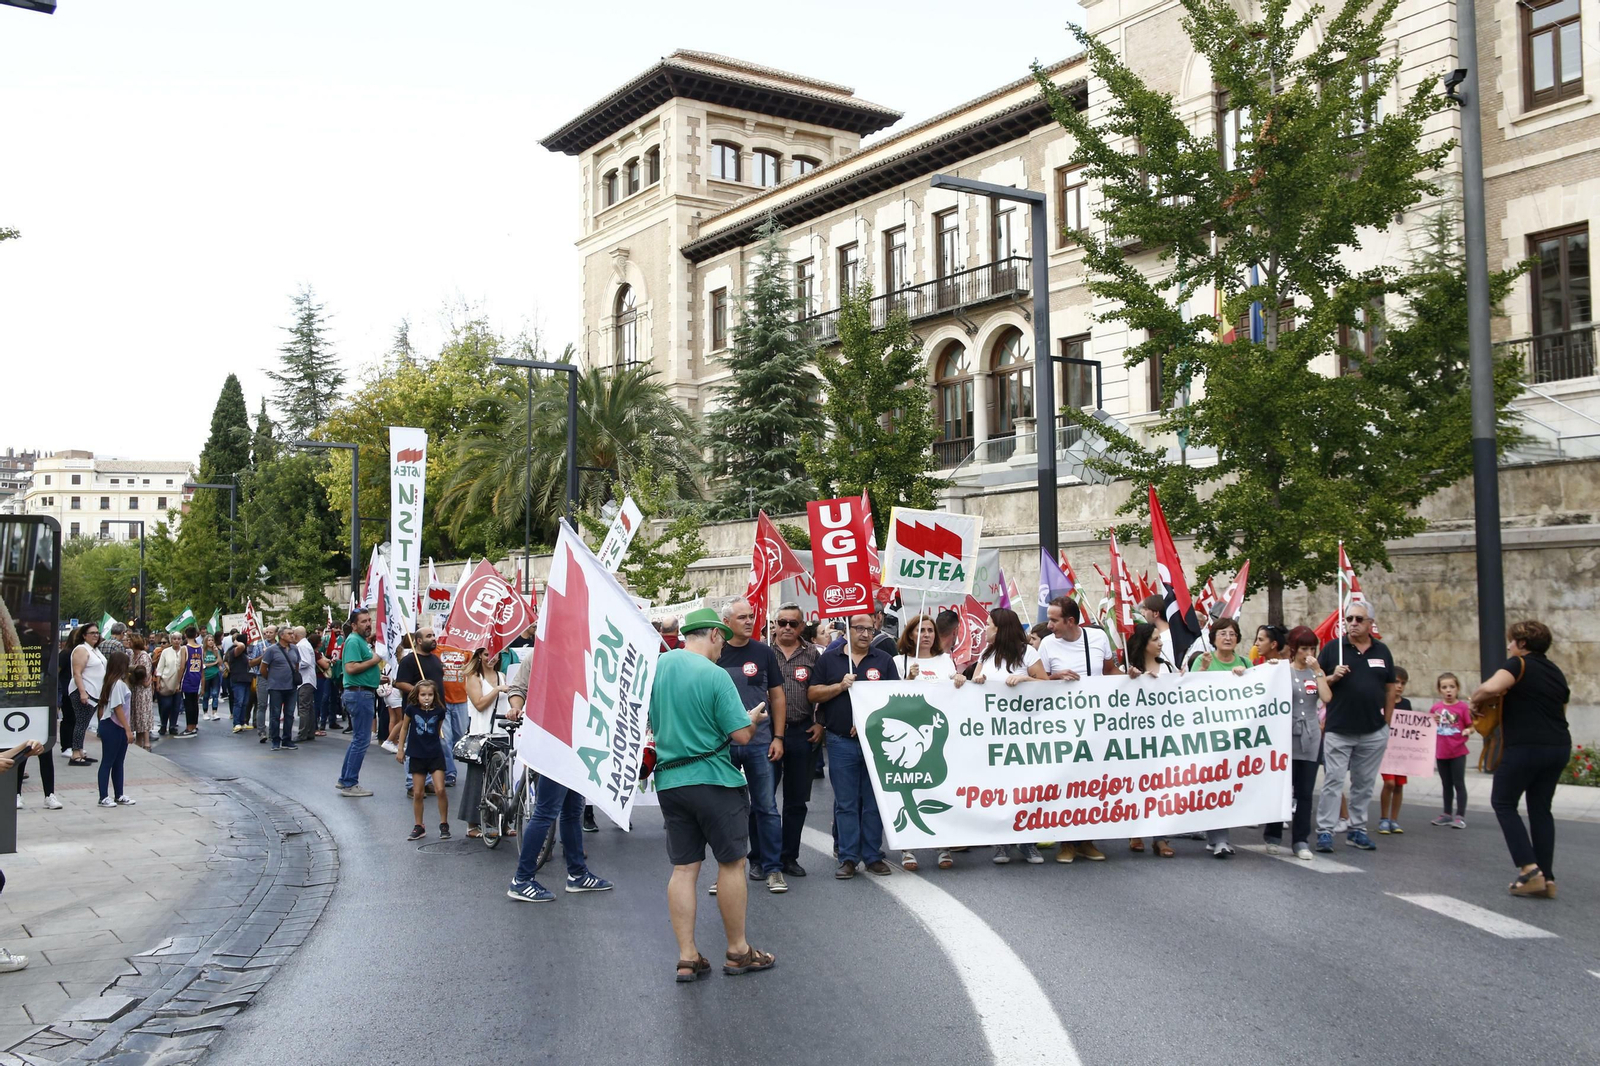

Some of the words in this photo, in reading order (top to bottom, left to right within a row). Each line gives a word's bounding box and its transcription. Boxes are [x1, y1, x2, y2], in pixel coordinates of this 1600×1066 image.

[818, 502, 858, 583] UGT
[900, 559, 966, 582] USTEA
[428, 602, 450, 611] USTEA
[11, 673, 20, 681] IS
[22, 673, 41, 681] OUR
[189, 659, 201, 673] 23
[984, 690, 1100, 712] Federación
[1108, 689, 1130, 708] de
[1135, 682, 1266, 707] Asociaciones
[959, 717, 985, 737] de
[991, 717, 1067, 736] Madres
[1075, 718, 1086, 738] y
[1093, 712, 1156, 732] Padres
[1161, 709, 1185, 728] de
[1192, 697, 1291, 725] alumnado
[988, 740, 1094, 766] FAMPA
[1103, 724, 1273, 762] ALHAMBRA
[885, 772, 934, 785] FAMPA
[1013, 781, 1061, 805] una
[1066, 773, 1134, 802] mejor
[1138, 758, 1233, 793] calidad
[1237, 755, 1265, 778] de
[1270, 749, 1289, 772] la
[1012, 798, 1141, 832] Educación
